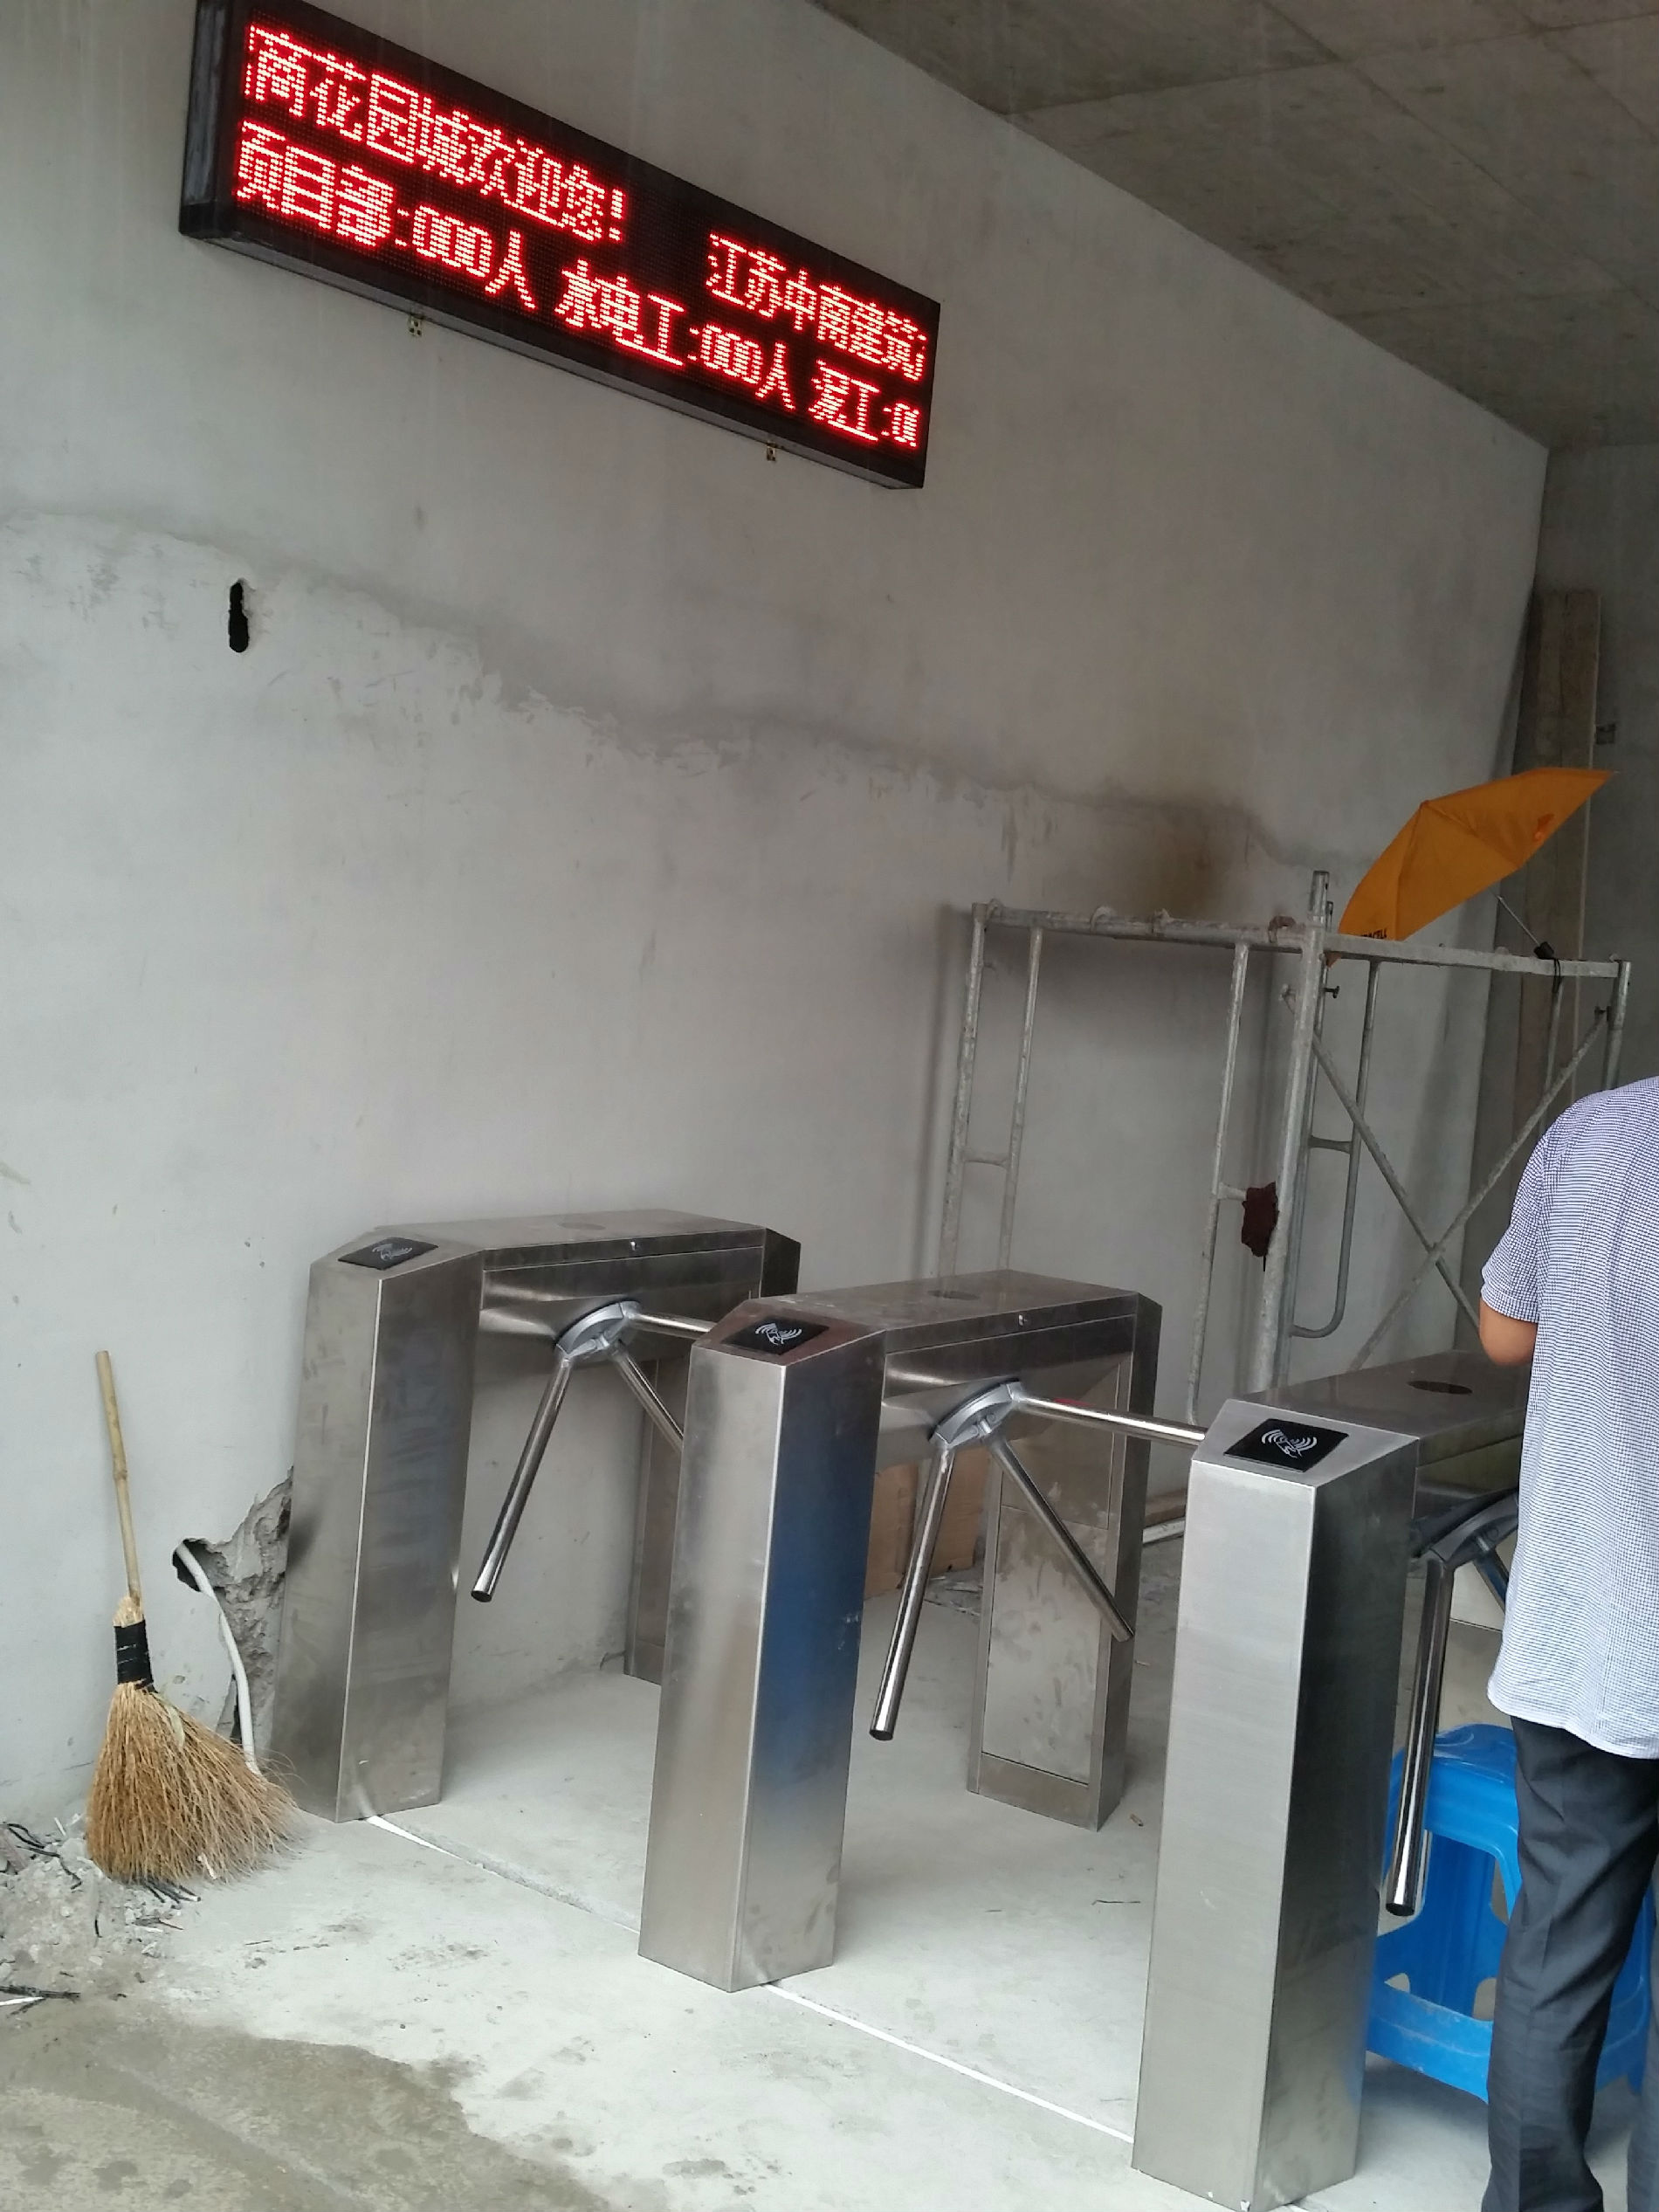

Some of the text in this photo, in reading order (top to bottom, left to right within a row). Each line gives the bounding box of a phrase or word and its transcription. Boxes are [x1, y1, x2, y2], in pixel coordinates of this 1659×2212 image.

[706, 232, 927, 381] 江苏中南建筑
